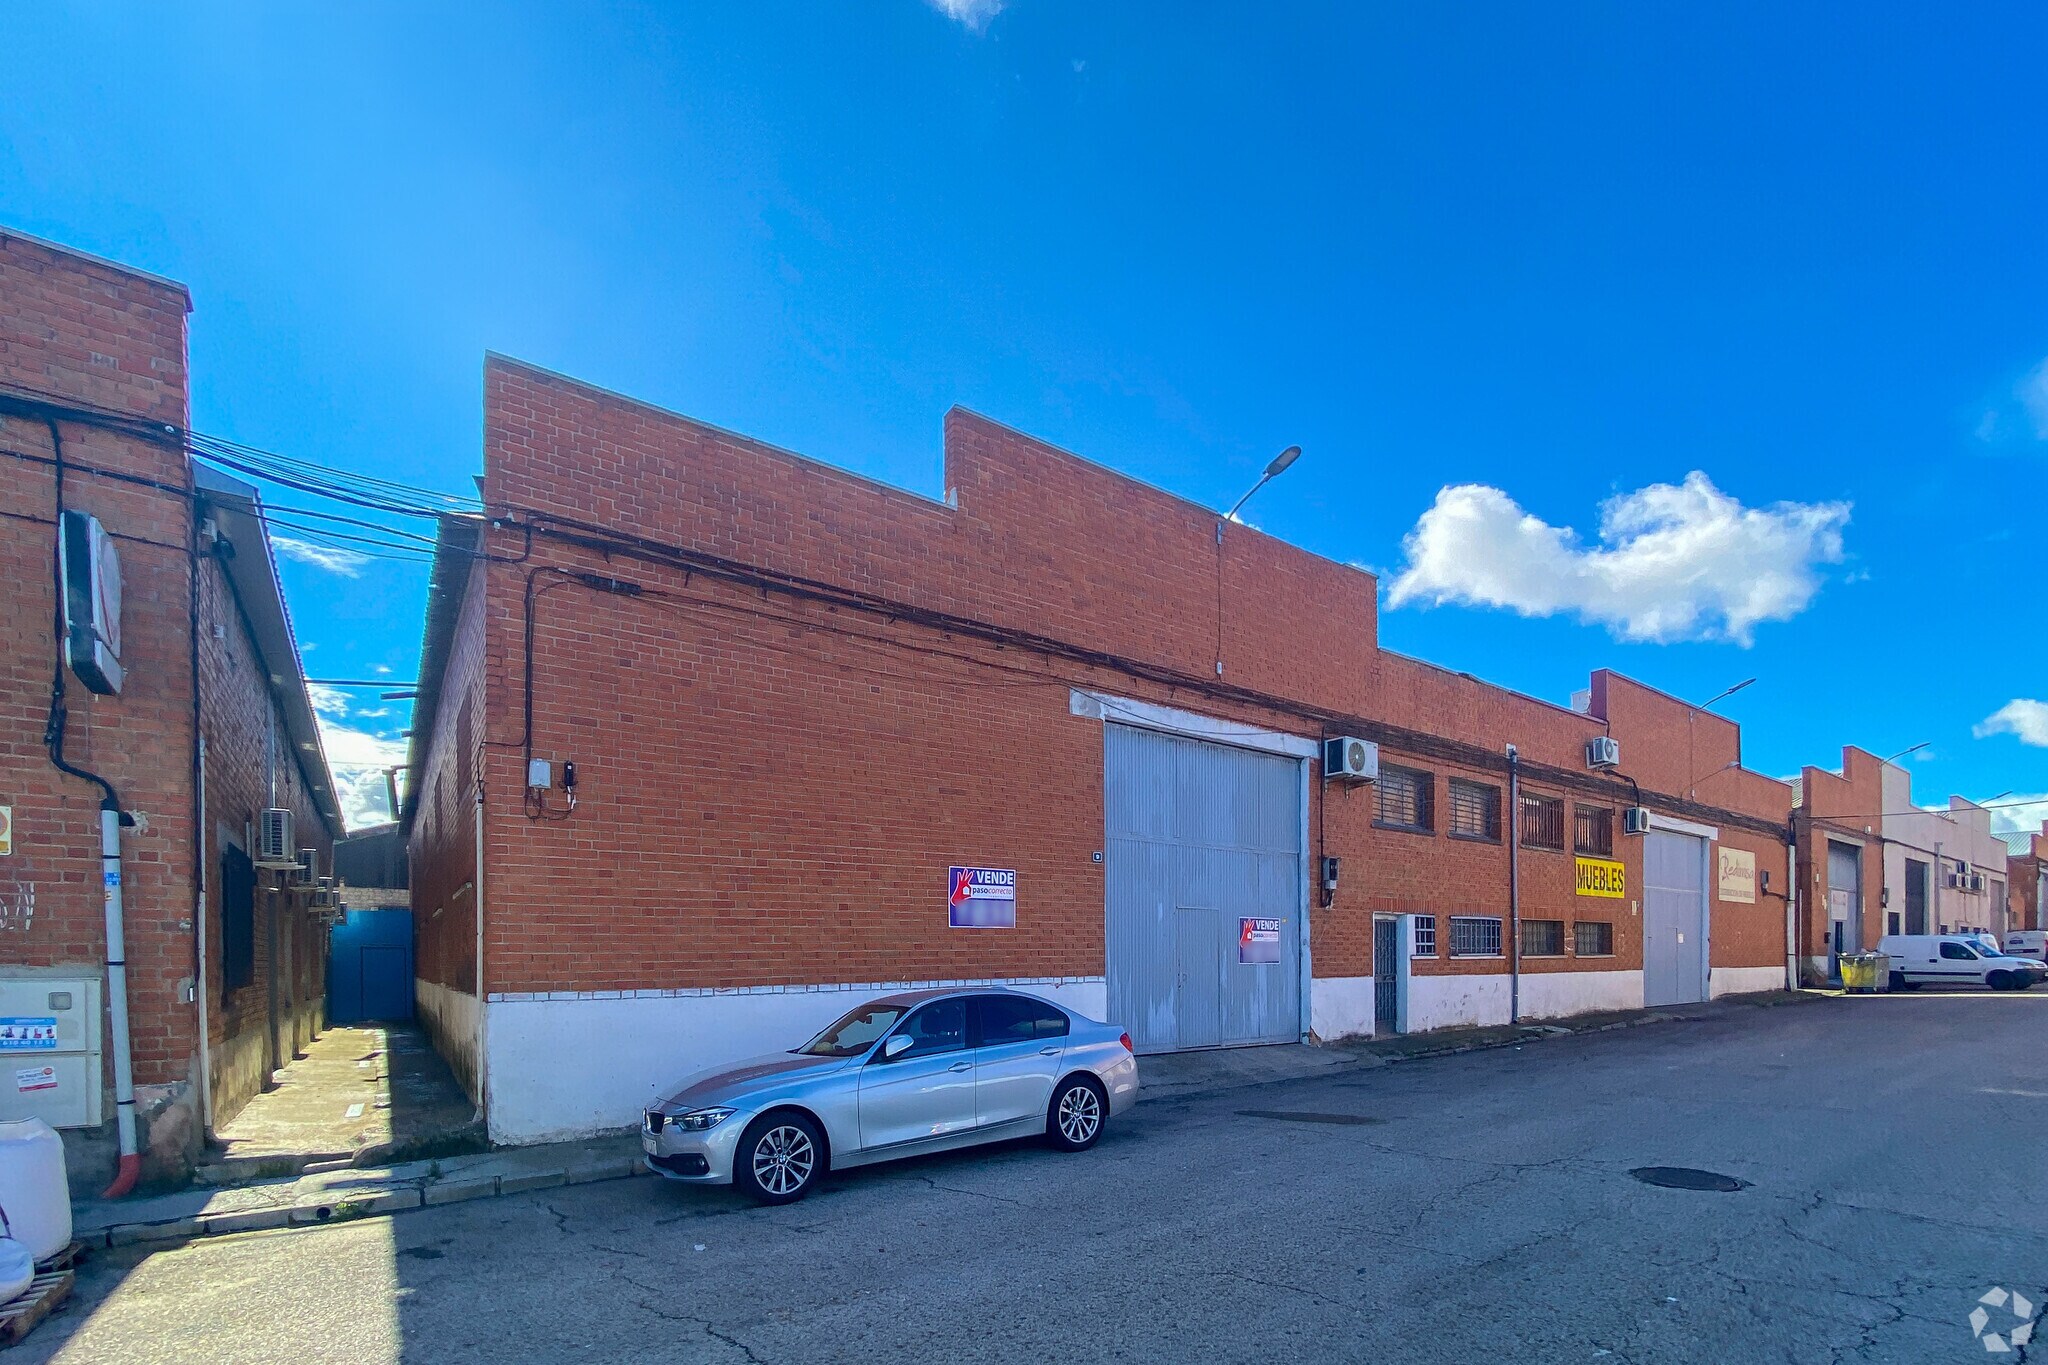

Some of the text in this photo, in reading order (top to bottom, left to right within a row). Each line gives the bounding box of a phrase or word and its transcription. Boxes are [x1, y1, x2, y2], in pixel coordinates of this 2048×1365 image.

[977, 871, 1014, 884] VENDE
[1577, 863, 1624, 893] MUEBLES
[972, 887, 1012, 895] pasocorrecto
[1256, 920, 1279, 930] VENDE
